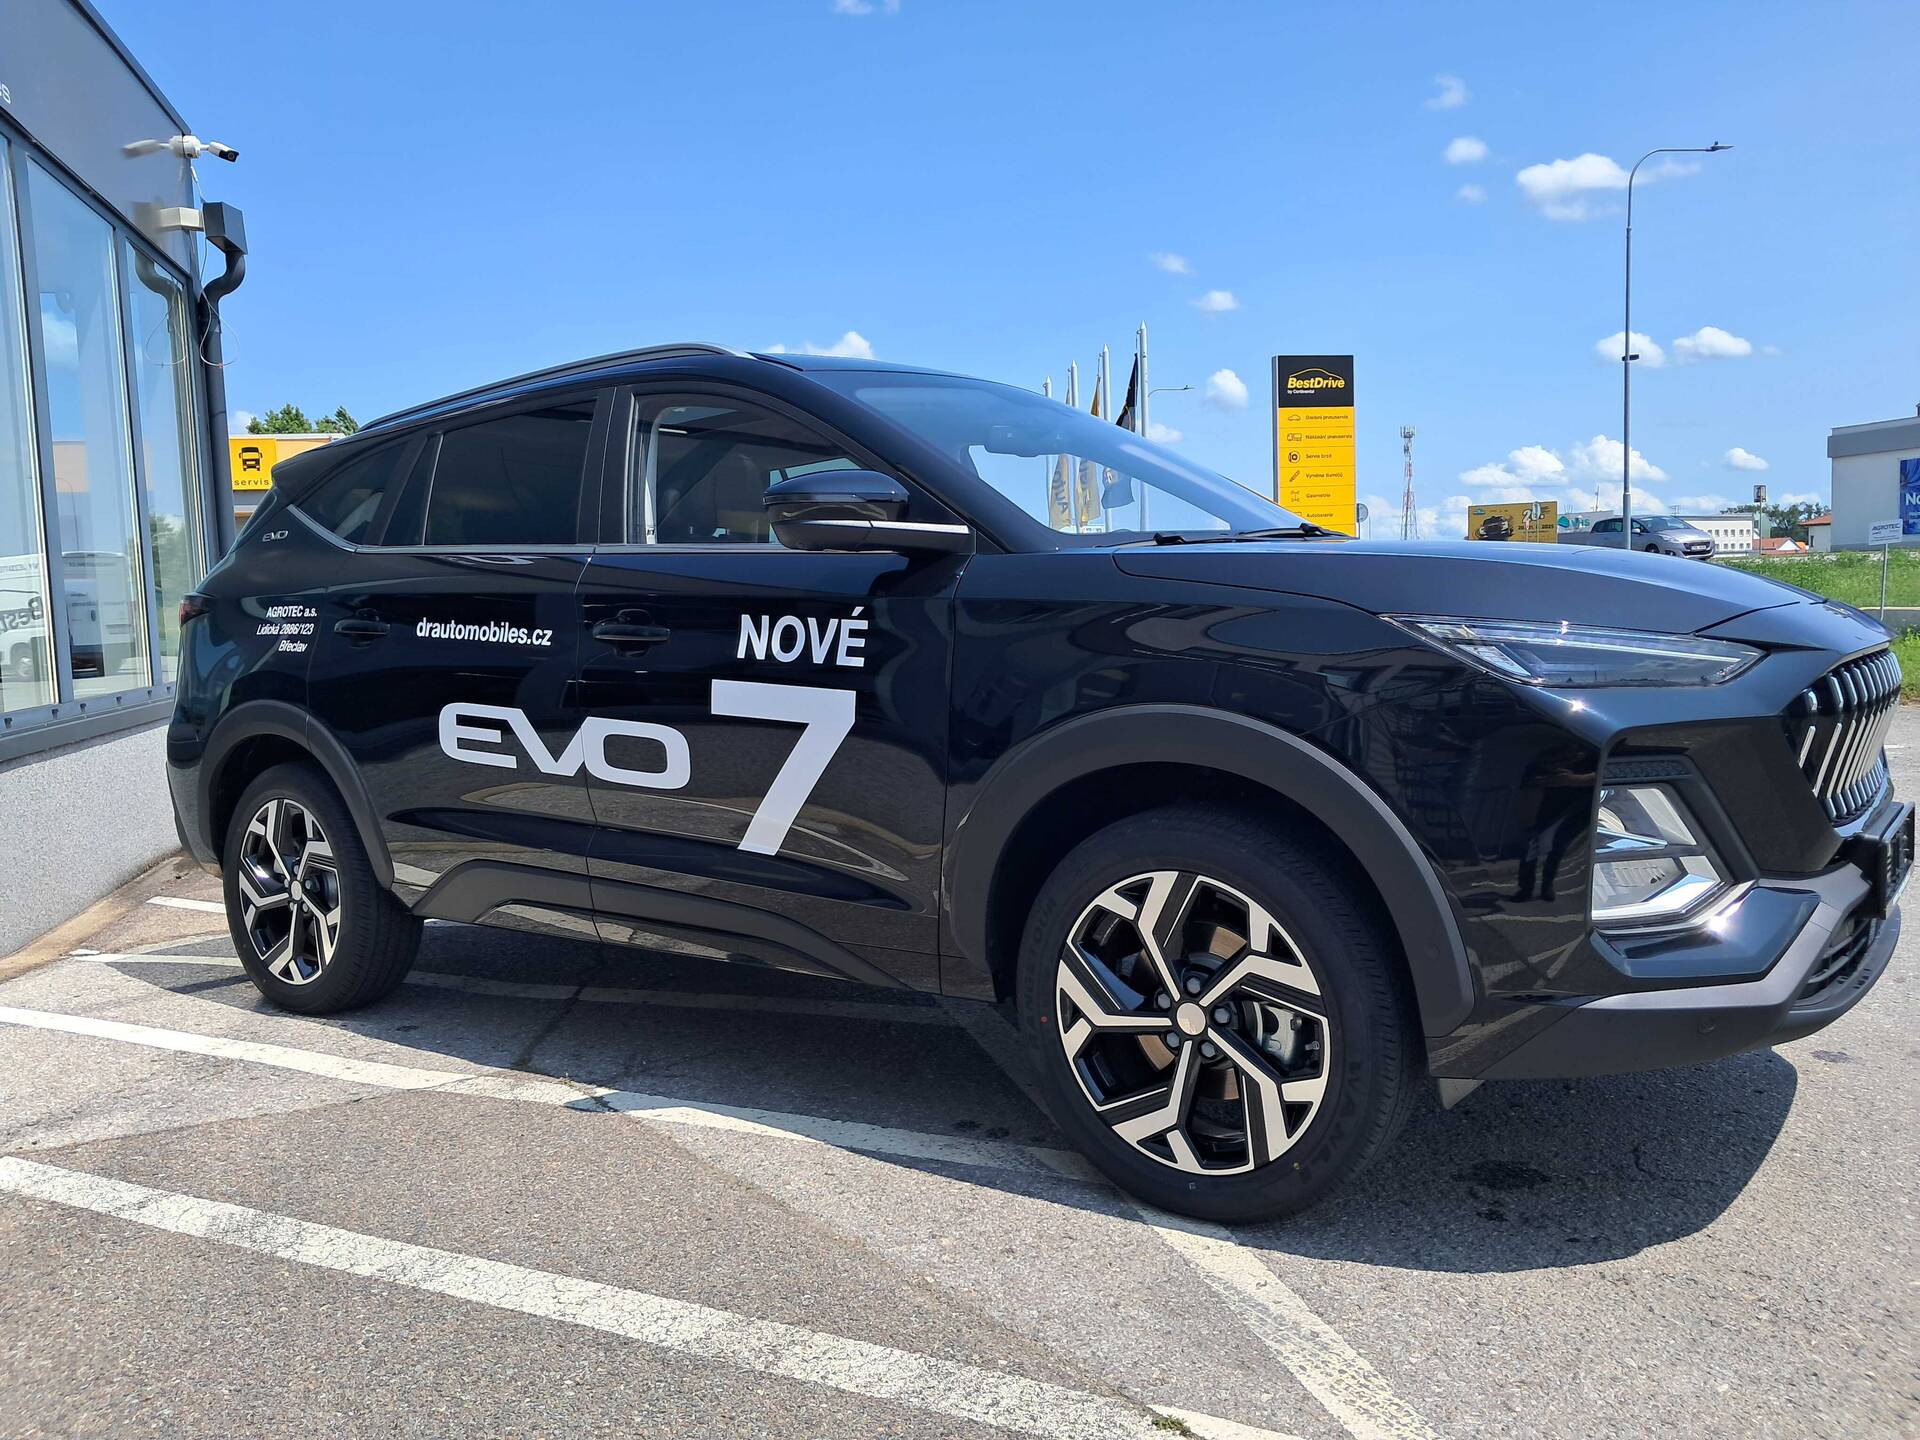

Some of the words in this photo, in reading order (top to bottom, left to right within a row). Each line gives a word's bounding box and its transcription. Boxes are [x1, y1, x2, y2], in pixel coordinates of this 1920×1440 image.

[1287, 377, 1345, 389] BestDrive
[233, 478, 270, 486] servis
[262, 530, 289, 542] EVO
[266, 605, 304, 618] AGROTEC
[303, 607, 318, 617] a.s.
[416, 617, 552, 647] drautomobiles.cz
[736, 606, 869, 668] NOVÉ
[278, 640, 308, 652] Břeclav
[438, 702, 692, 790] EVO
[711, 678, 857, 856] 7
